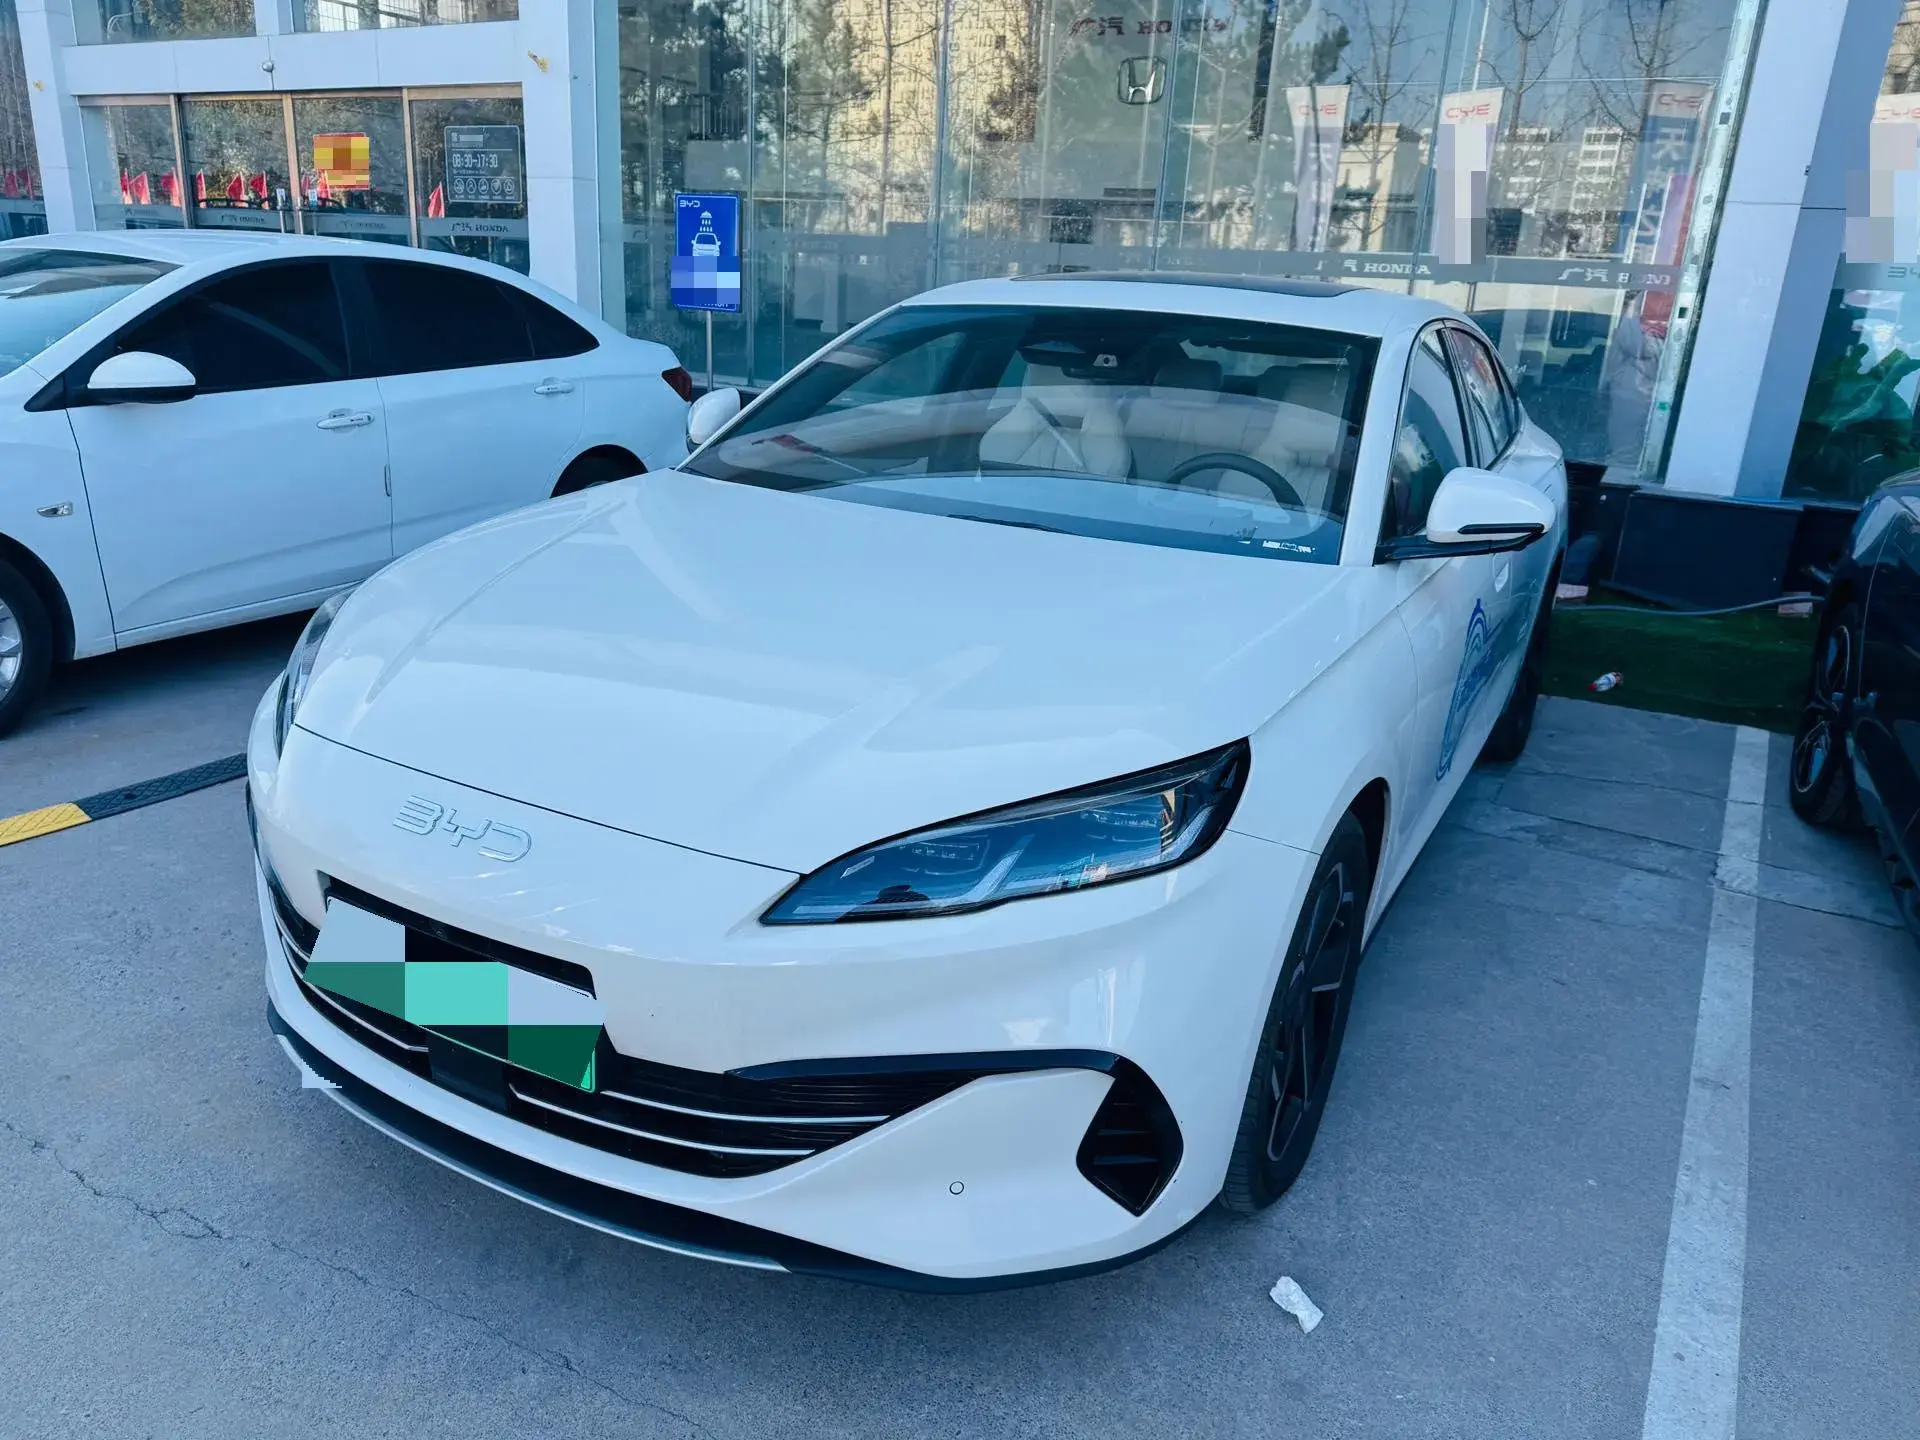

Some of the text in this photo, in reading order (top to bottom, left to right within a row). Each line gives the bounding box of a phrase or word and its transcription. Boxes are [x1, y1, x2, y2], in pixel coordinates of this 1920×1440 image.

[680, 200, 701, 208] BYD
[1558, 267, 1608, 282] 广汽
[393, 794, 532, 863] BYD
